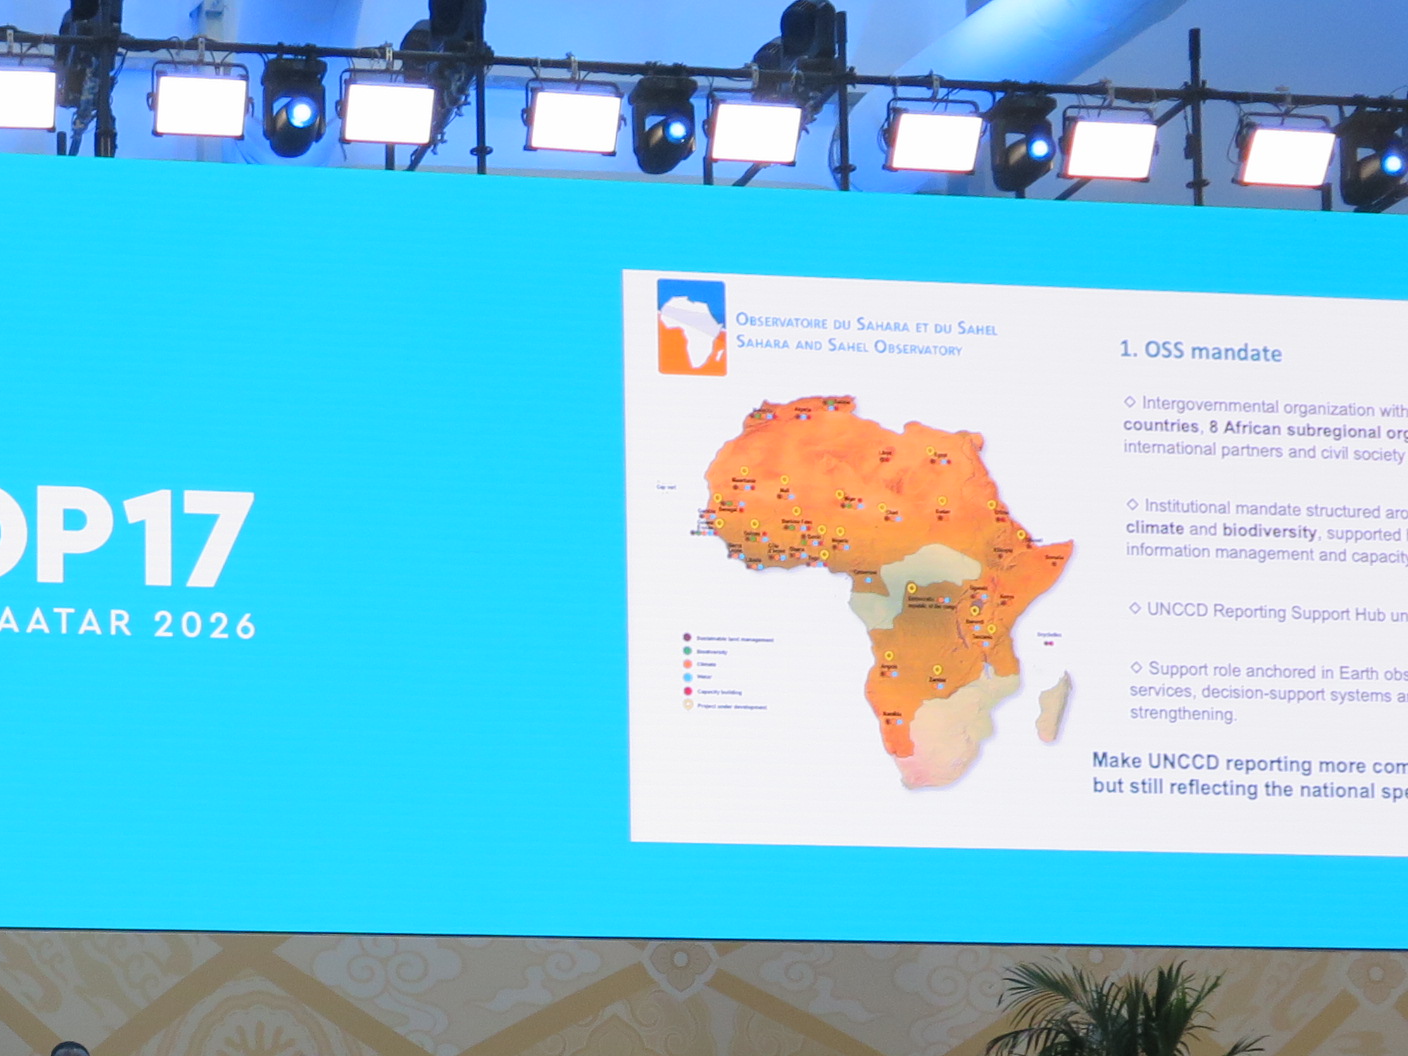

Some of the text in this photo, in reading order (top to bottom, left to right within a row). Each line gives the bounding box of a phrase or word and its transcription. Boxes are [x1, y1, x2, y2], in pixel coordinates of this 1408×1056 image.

[1121, 340, 1282, 362] 1. OSS mandate
[1143, 396, 1408, 418] Intergovernmental organization with
[1124, 419, 1203, 434] countries,
[1210, 420, 1218, 433] 8
[1224, 421, 1281, 435] African
[1287, 423, 1381, 441] subregional
[1124, 439, 1405, 465] international partners and civil society
[1146, 498, 1230, 514] Institutional
[1236, 502, 1301, 516] mandate
[1306, 504, 1381, 519] structured
[1126, 520, 1401, 543] climate and biodiversity, supported
[1127, 542, 1210, 558] information
[1216, 548, 1314, 563] management
[1319, 549, 1346, 562] and
[1148, 602, 1208, 617] UNCCD
[1214, 604, 1286, 622] Reporting
[1292, 606, 1350, 623] Support
[1356, 608, 1386, 622] Hub
[155, 611, 256, 639] 2026
[1149, 661, 1208, 678] Support
[1214, 663, 1241, 677] role
[1246, 664, 1316, 679] anchored
[1322, 666, 1334, 679] in
[1340, 666, 1378, 680] Earth
[1130, 684, 1196, 699] services,
[1202, 685, 1325, 703] decision-support
[1330, 689, 1392, 705] systems
[1131, 706, 1237, 724] strengthening.
[1093, 752, 1141, 768] Make
[1149, 753, 1219, 770] UNCCD
[1226, 756, 1312, 776] reporting
[1319, 761, 1366, 773] more
[1093, 777, 1124, 793] but
[1130, 778, 1163, 794] still
[1170, 779, 1258, 800] reflecting
[1265, 781, 1293, 797] the
[1301, 782, 1375, 798] national
